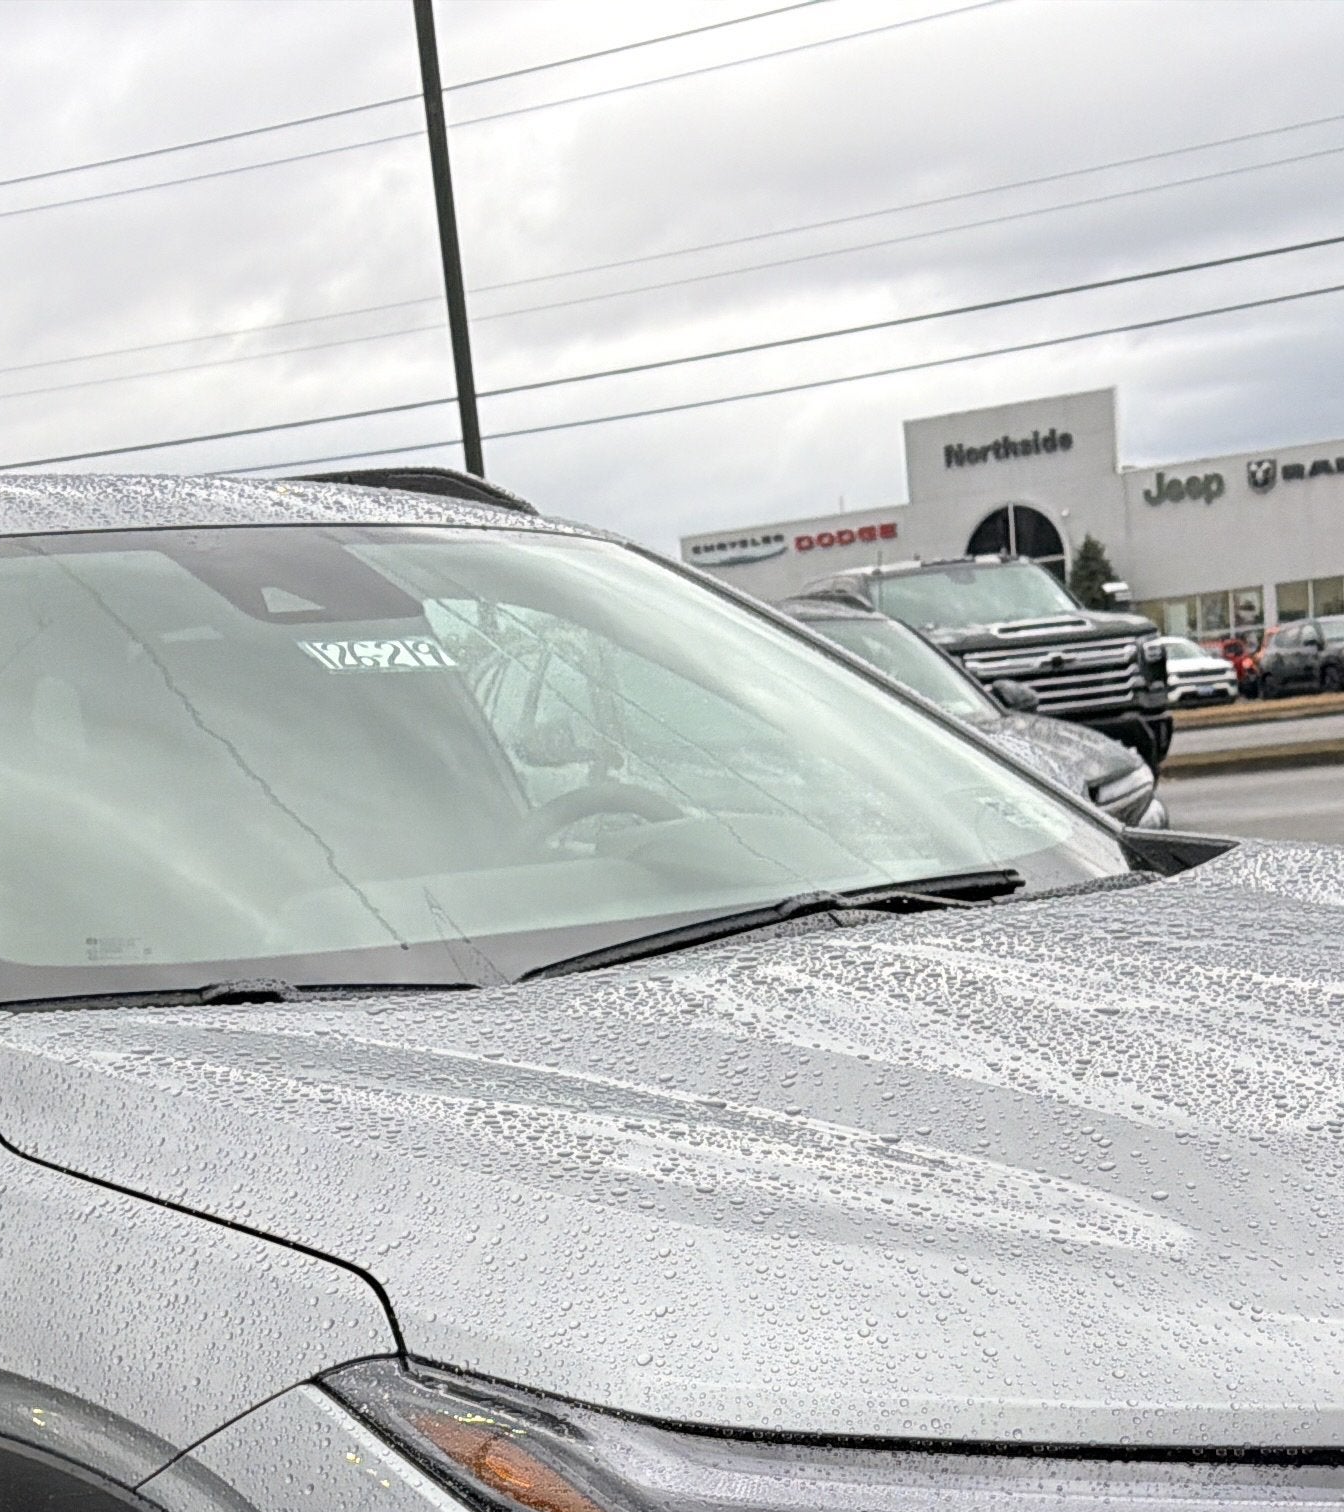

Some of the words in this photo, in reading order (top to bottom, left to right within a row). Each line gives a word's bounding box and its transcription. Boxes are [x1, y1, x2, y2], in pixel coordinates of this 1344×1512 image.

[943, 427, 1074, 469] Northside
[1143, 471, 1226, 506] Jeep
[692, 533, 785, 554] CHRYSLER
[794, 522, 898, 552] DODGE
